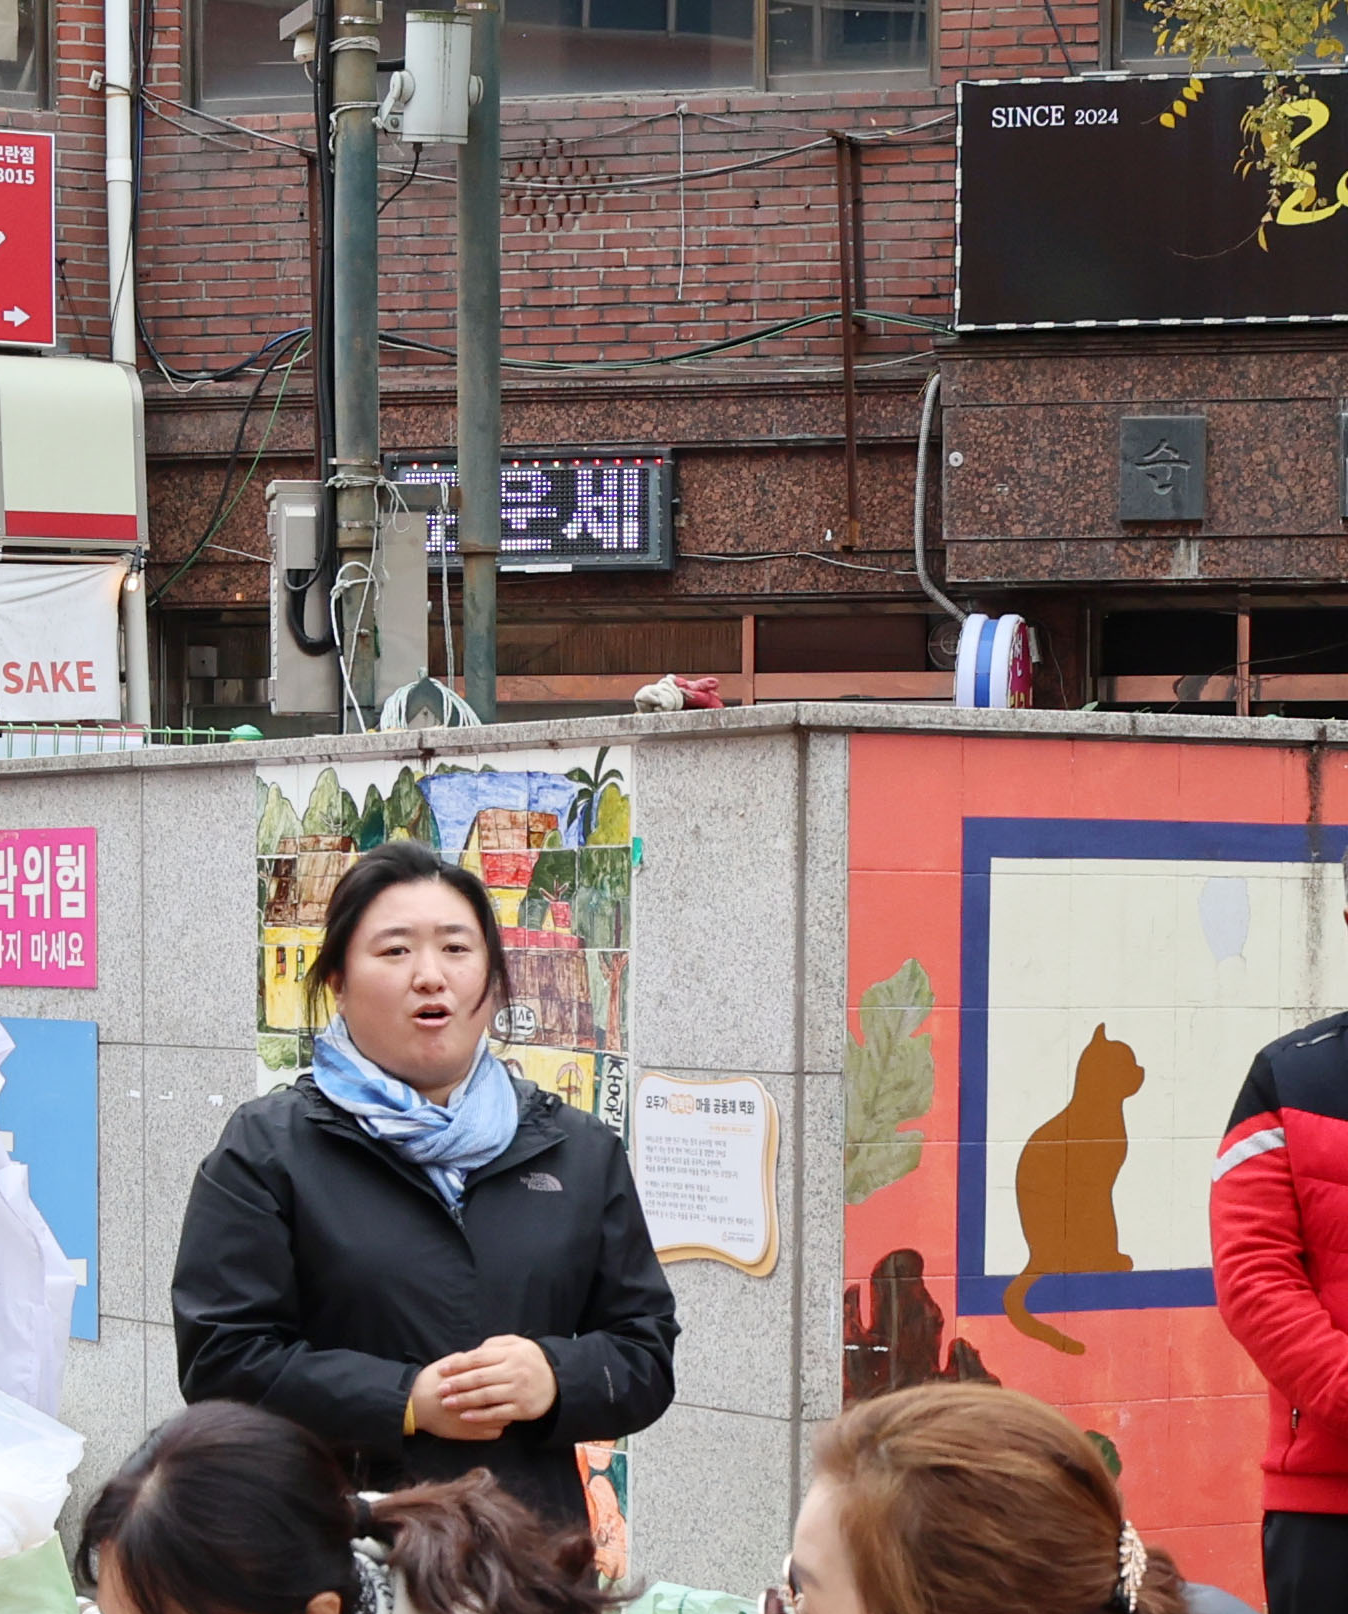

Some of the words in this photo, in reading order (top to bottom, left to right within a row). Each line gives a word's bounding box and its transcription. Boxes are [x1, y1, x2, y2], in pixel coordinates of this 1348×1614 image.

[991, 105, 1065, 129] SINCE
[1074, 106, 1119, 127] 2024
[2, 660, 97, 696] SAKE
[30, 929, 86, 971] 마세요
